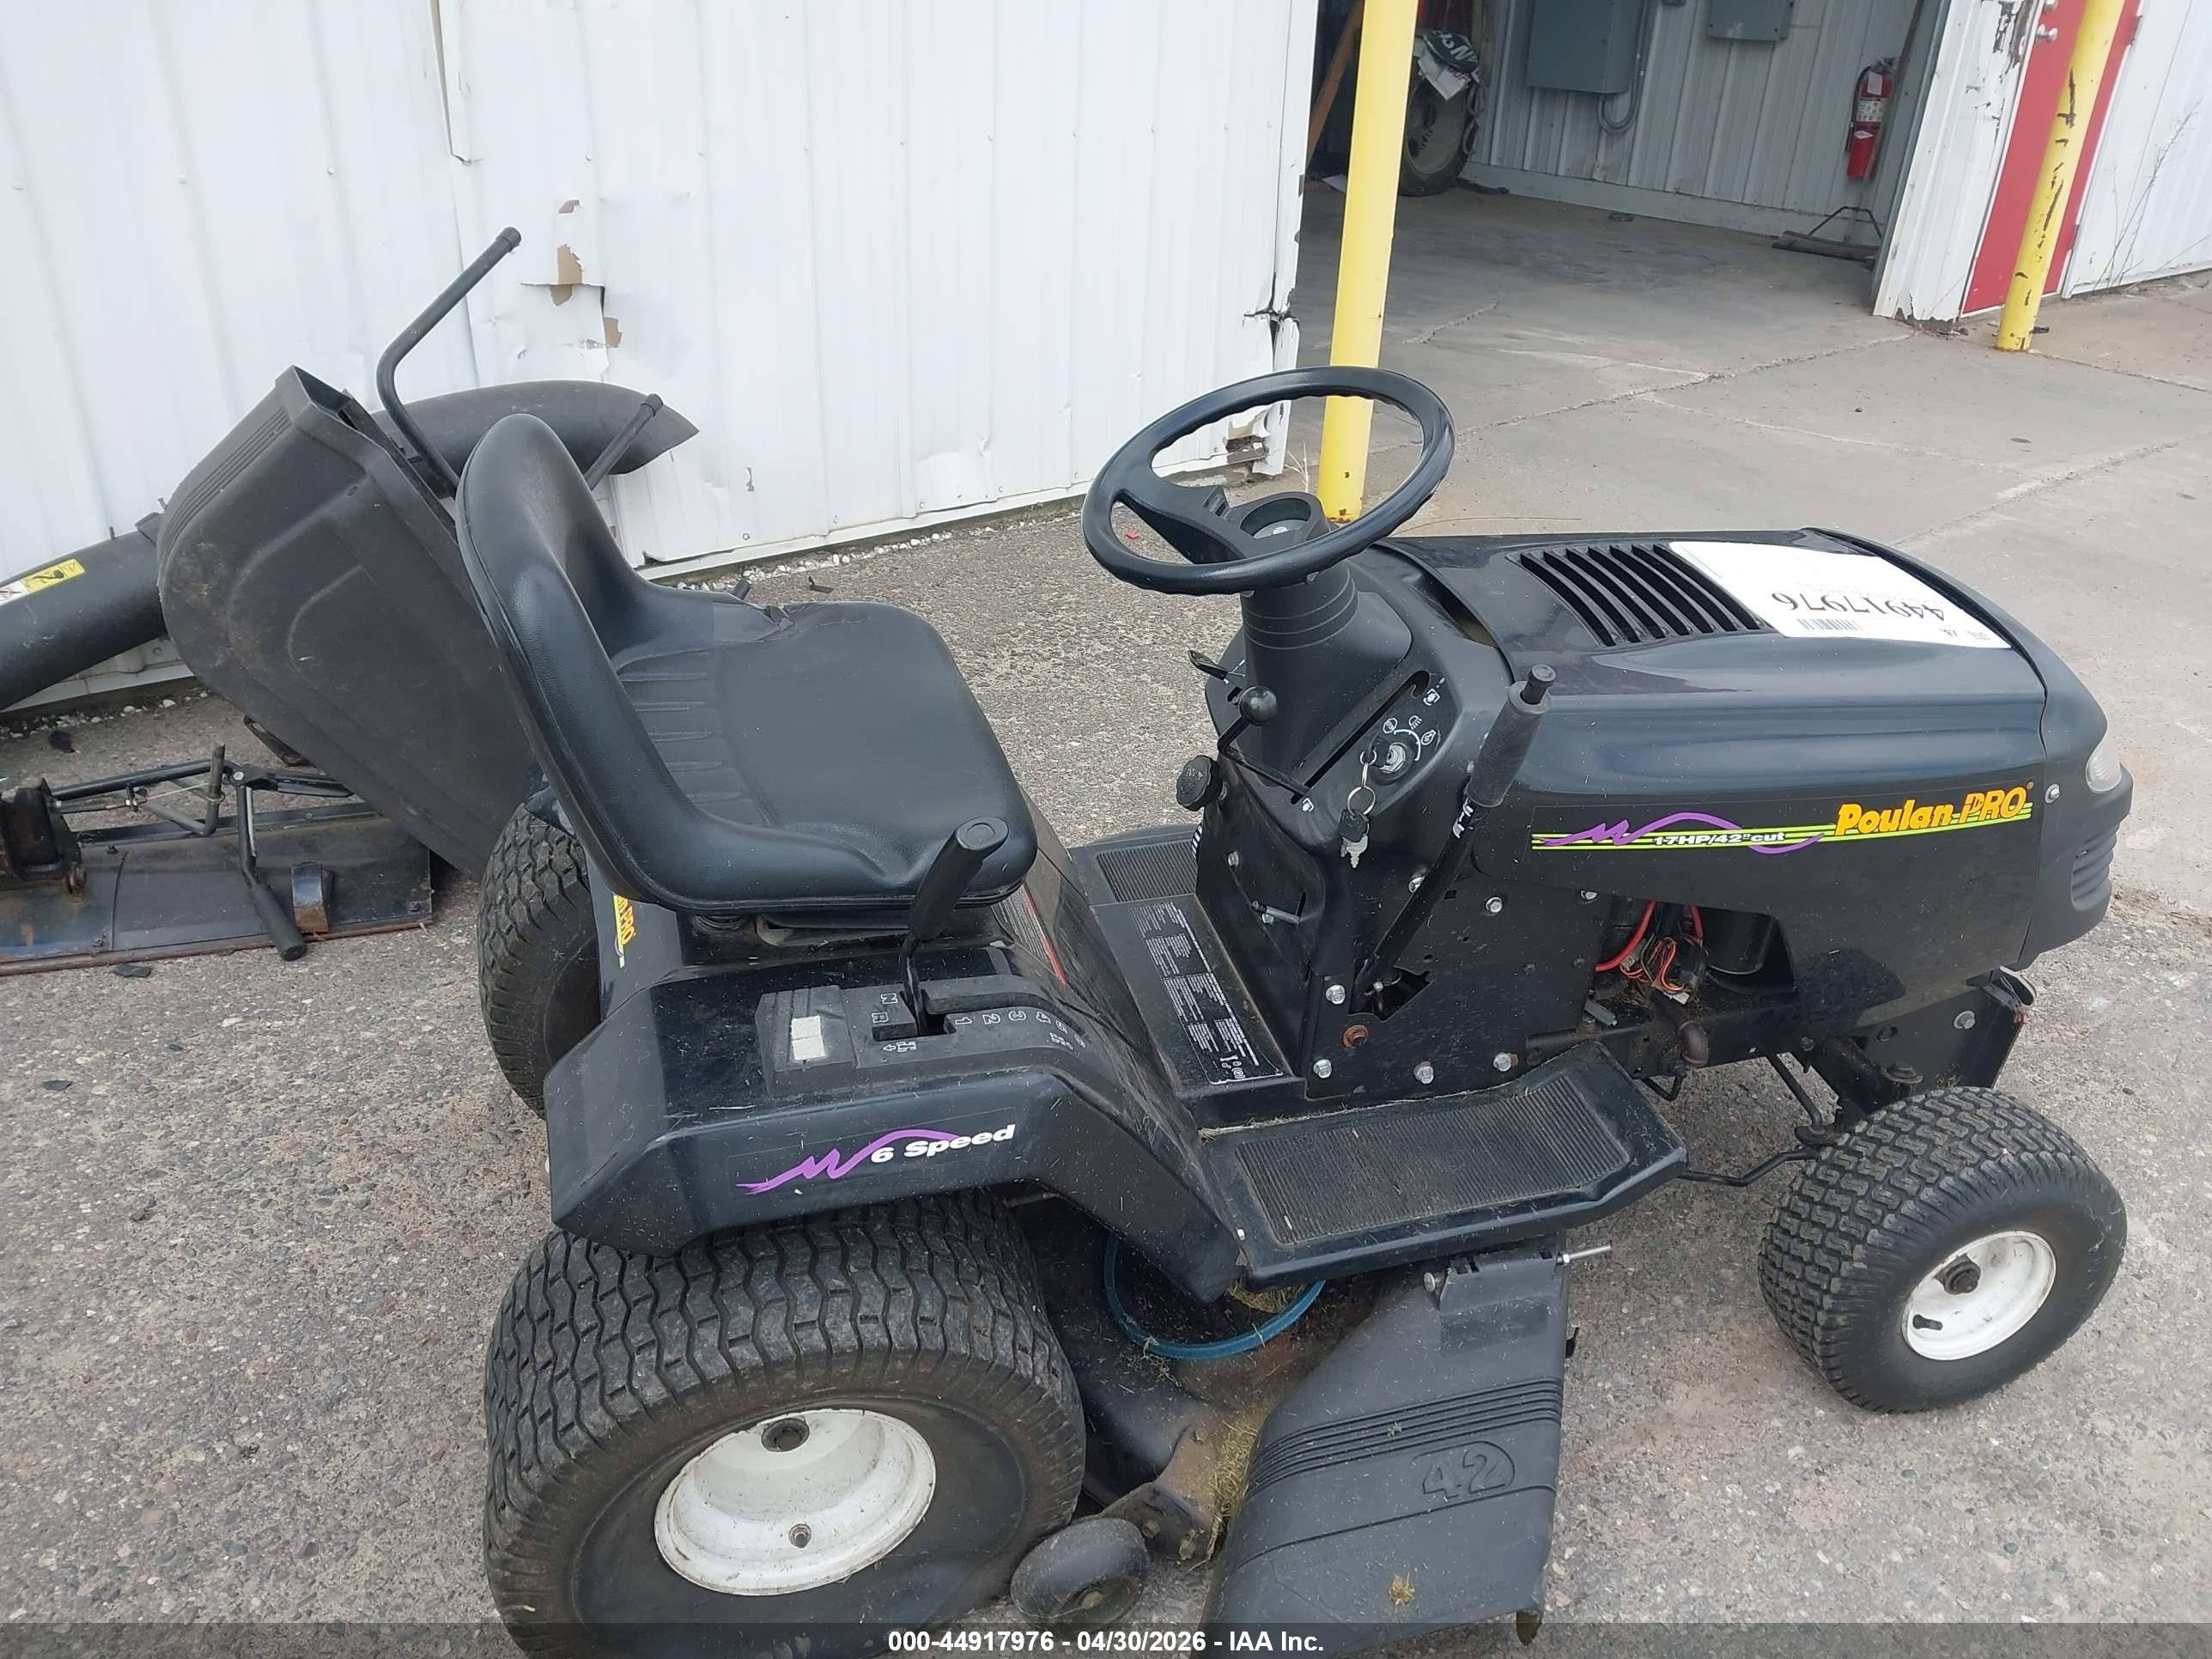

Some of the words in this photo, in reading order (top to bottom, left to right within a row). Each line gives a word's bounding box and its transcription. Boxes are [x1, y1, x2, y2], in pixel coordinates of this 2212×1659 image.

[1770, 592, 1945, 622] 44917976
[1834, 799, 1954, 836] Poulan
[955, 1016, 972, 1025] 1
[982, 1013, 1000, 1024] 2
[1008, 1010, 1026, 1021] 3
[871, 1146, 894, 1164] 6
[903, 1123, 1016, 1158] Speed
[1422, 1449, 1506, 1499] 42
